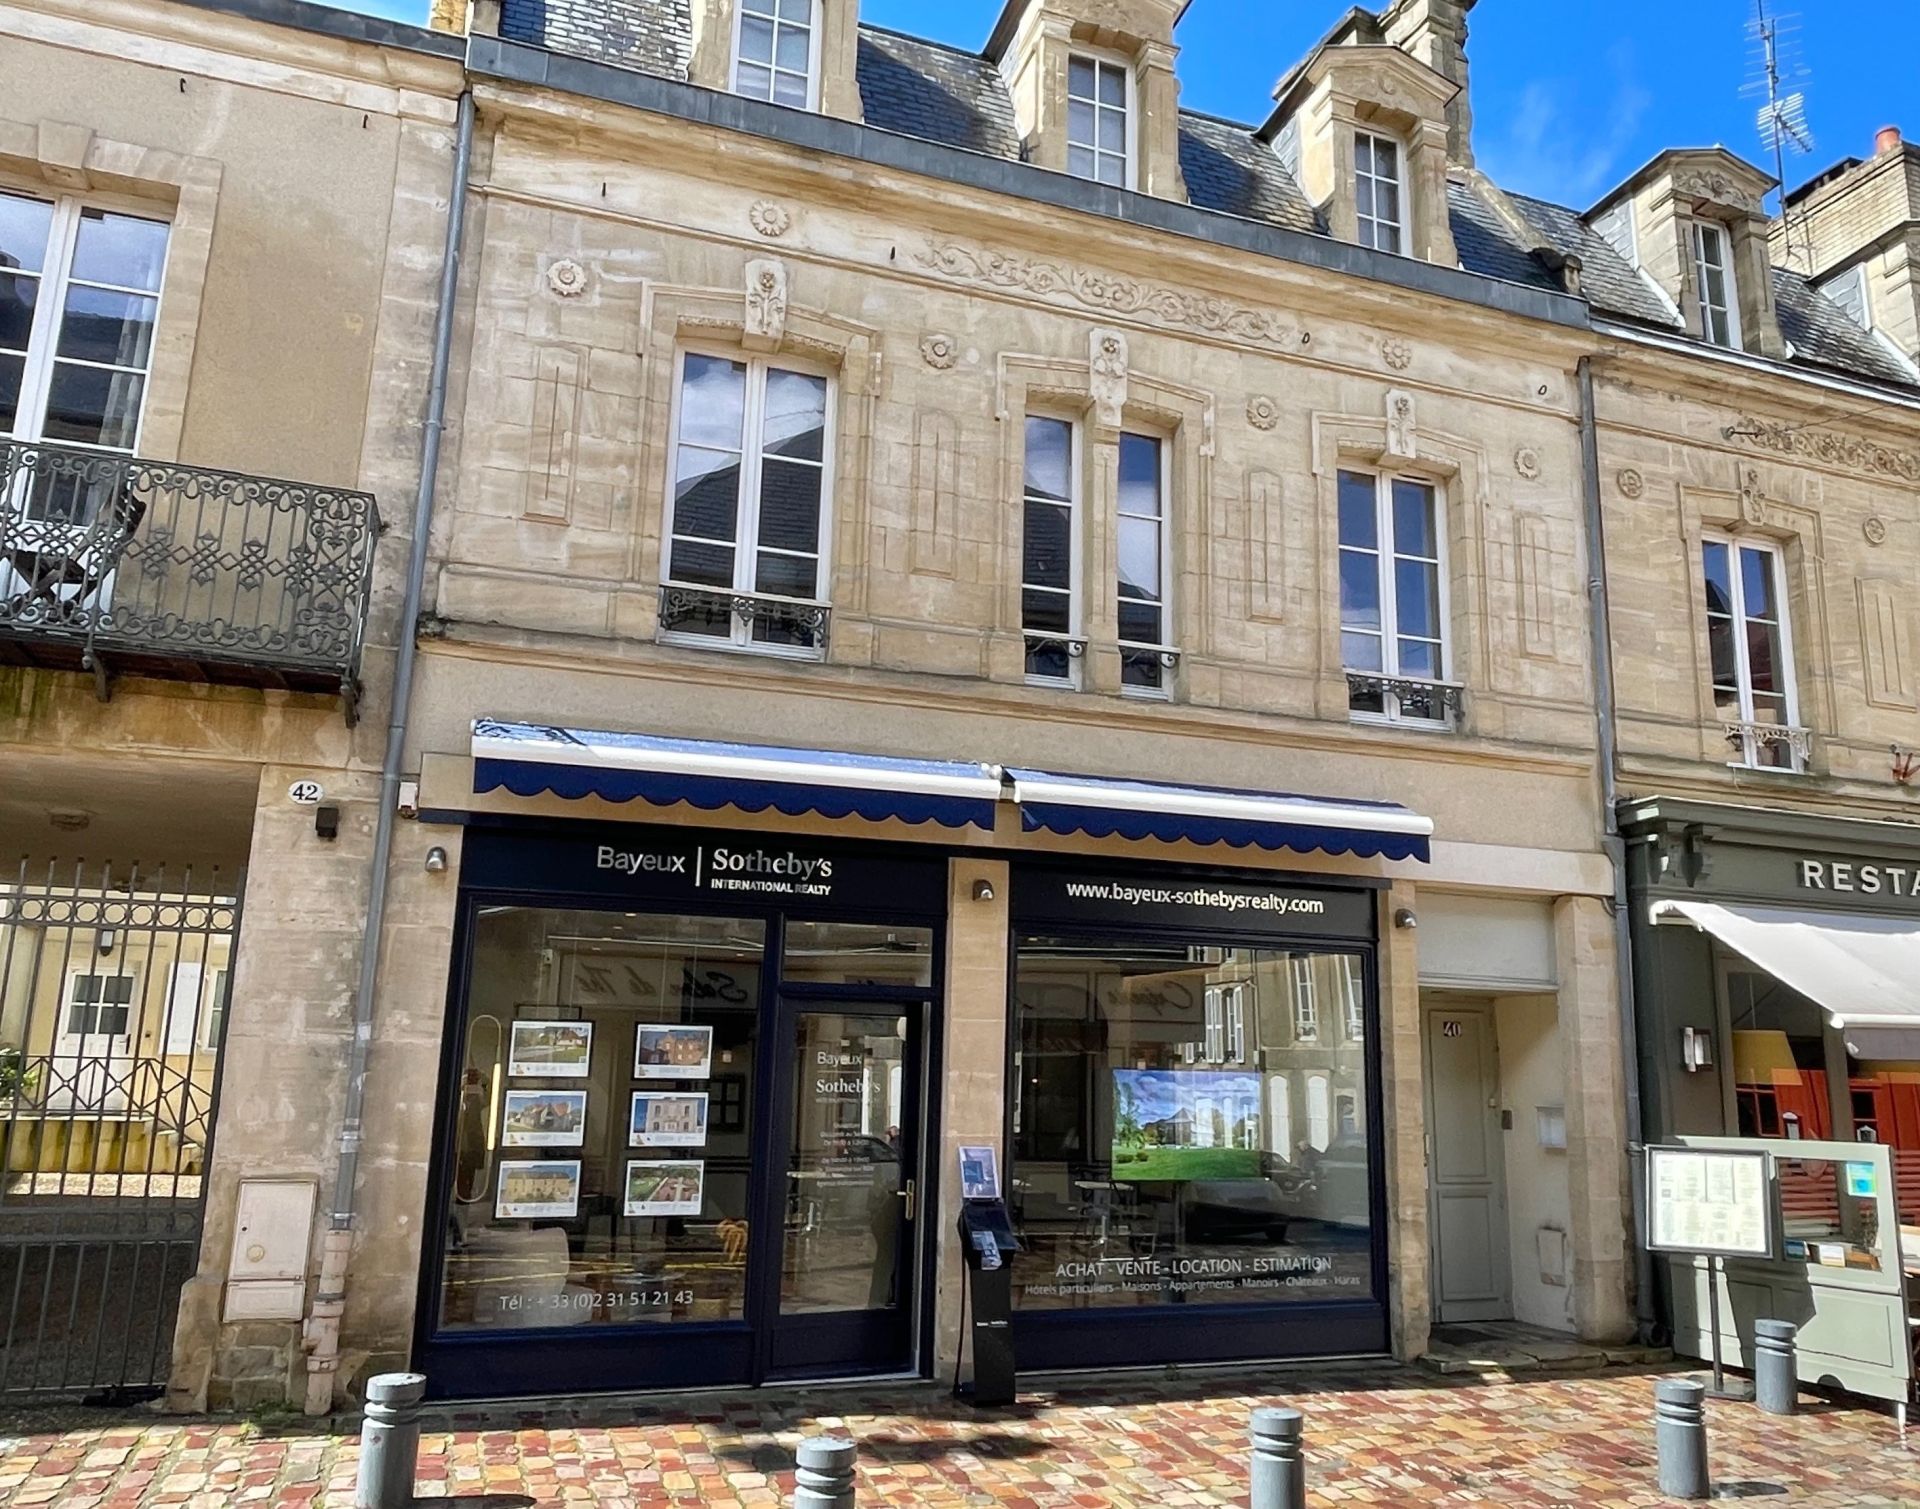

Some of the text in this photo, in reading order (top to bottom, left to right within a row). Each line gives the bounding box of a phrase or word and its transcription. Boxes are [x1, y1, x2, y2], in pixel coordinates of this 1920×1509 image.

[293, 783, 318, 800] 42
[597, 846, 832, 881] Bayeux Sotheby's
[711, 878, 832, 895] INTERNATIONAL REALTY
[1066, 883, 1324, 914] www.bayeux-sothebysrealty.com
[1444, 1022, 1461, 1037] 40
[817, 1051, 862, 1067] Bayeux
[816, 1078, 881, 1093] Sotheb's
[1055, 1262, 1105, 1277] ACHAT
[1116, 1260, 1161, 1275] VENTE
[1172, 1259, 1242, 1274] LOCATION
[1253, 1256, 1332, 1272] ESTIMATION
[1060, 1283, 1114, 1296] particuliers
[1122, 1281, 1162, 1292] Maisons
[1169, 1279, 1235, 1292] Appartements
[1242, 1278, 1279, 1288] Manoirs
[499, 1294, 523, 1310] Tél
[550, 1294, 569, 1309] 33
[573, 1292, 602, 1310] (0)2
[606, 1293, 624, 1307] 31
[629, 1292, 646, 1306] 51
[652, 1291, 669, 1305] 21
[674, 1290, 694, 1304] 43
